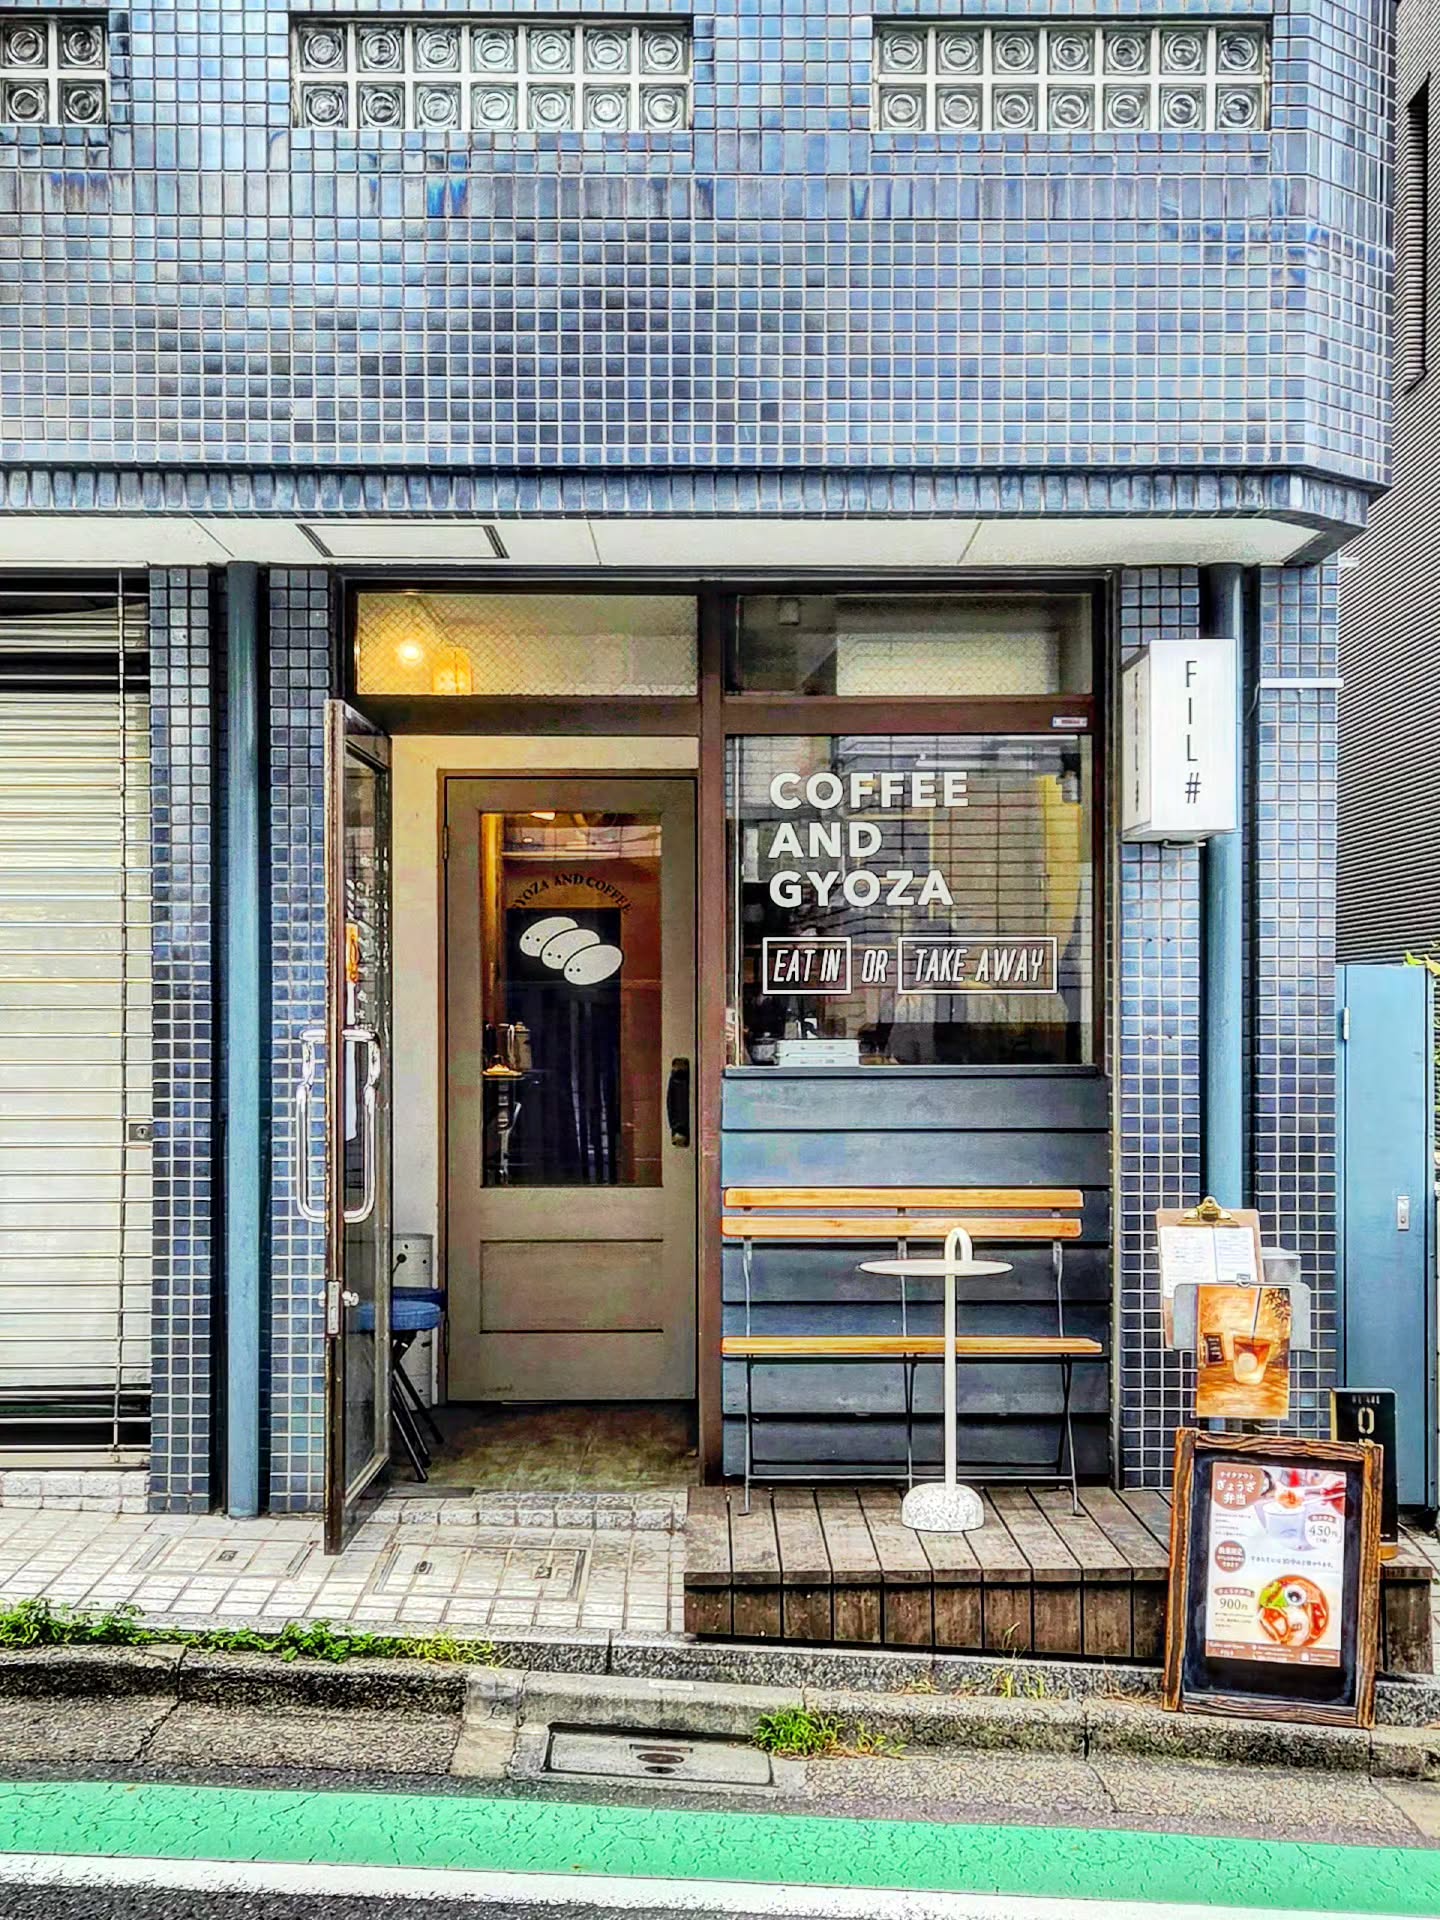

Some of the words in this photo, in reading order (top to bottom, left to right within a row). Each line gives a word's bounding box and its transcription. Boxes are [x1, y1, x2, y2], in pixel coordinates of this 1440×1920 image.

[1185, 660, 1202, 804] FIL#
[769, 772, 969, 809] COFFEE
[768, 822, 882, 858] AND
[555, 873, 586, 887] AND
[588, 876, 634, 916] COFFEE
[769, 870, 954, 908] GYOZA
[773, 949, 816, 982] EAT
[819, 948, 842, 983] IN
[861, 949, 889, 984] OR
[915, 948, 967, 983] TAKE
[975, 948, 1044, 983] AWAY
[1216, 1480, 1257, 1493] ぎょうざ
[1223, 1493, 1247, 1505] 弁当
